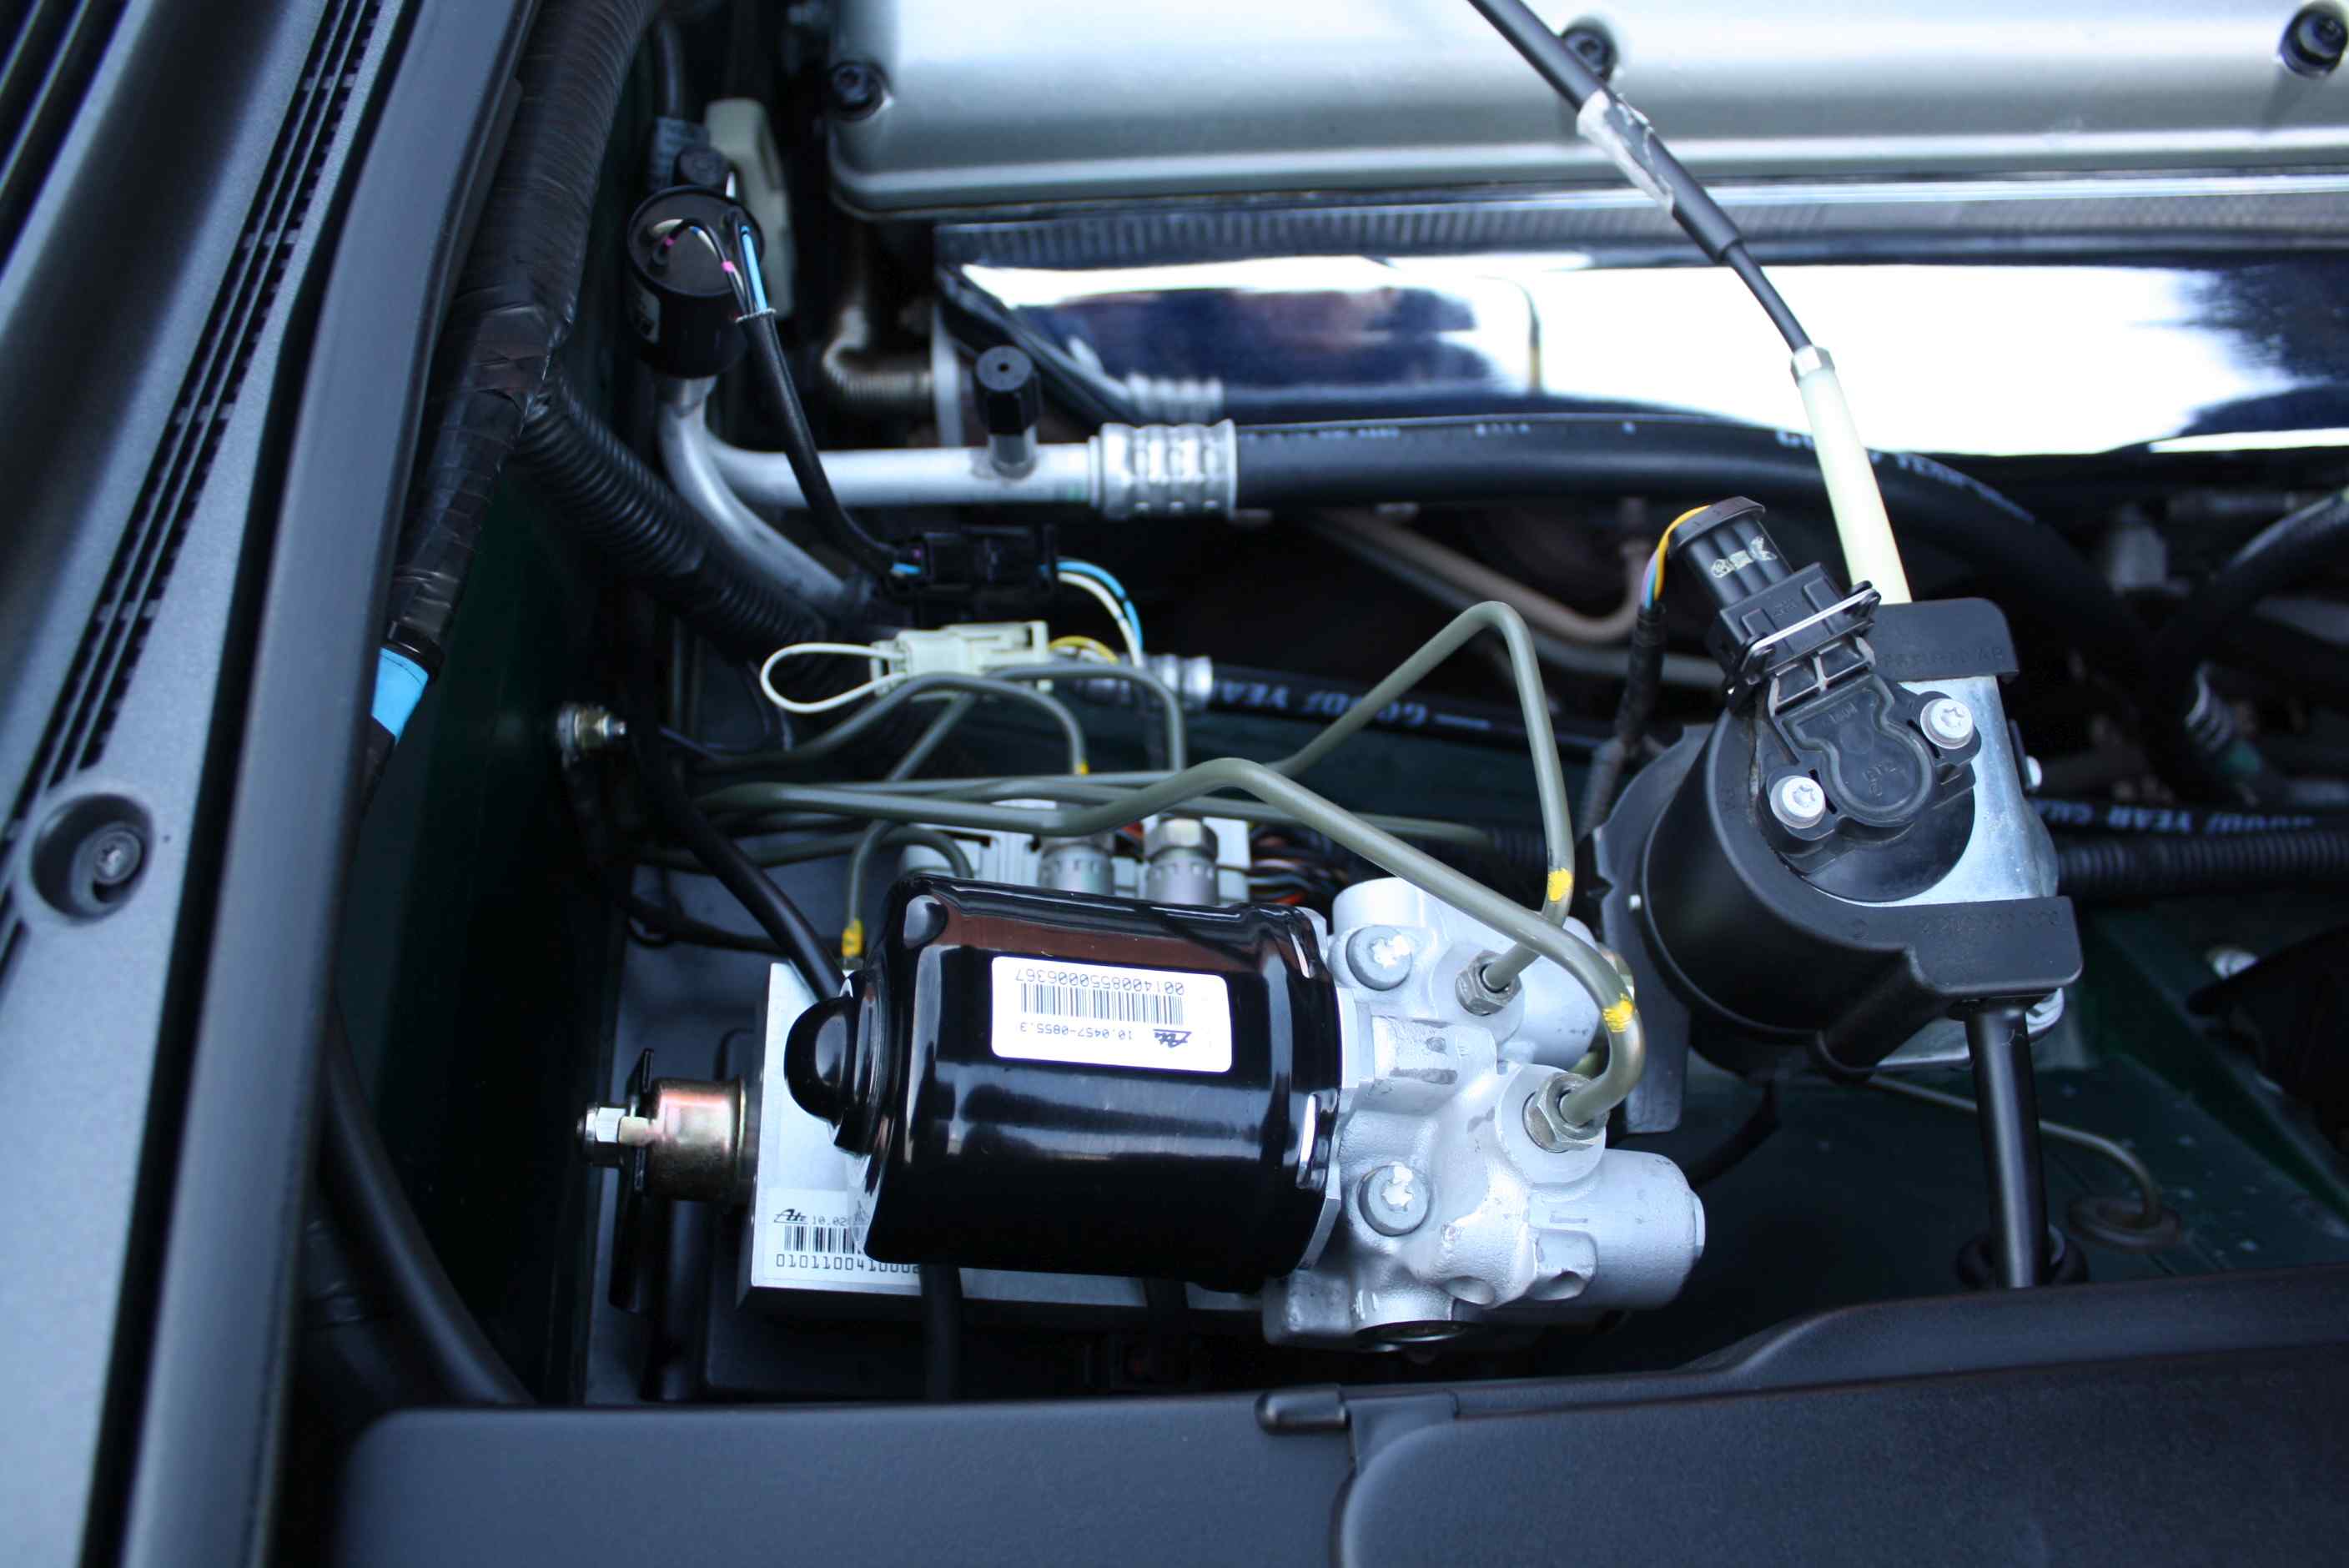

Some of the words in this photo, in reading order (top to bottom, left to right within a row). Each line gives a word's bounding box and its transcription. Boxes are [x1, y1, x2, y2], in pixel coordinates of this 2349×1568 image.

[1211, 680, 1290, 711] YEA
[1014, 967, 1185, 997] 0014008550006367
[1019, 1021, 1135, 1041] 10.0457-0855.3
